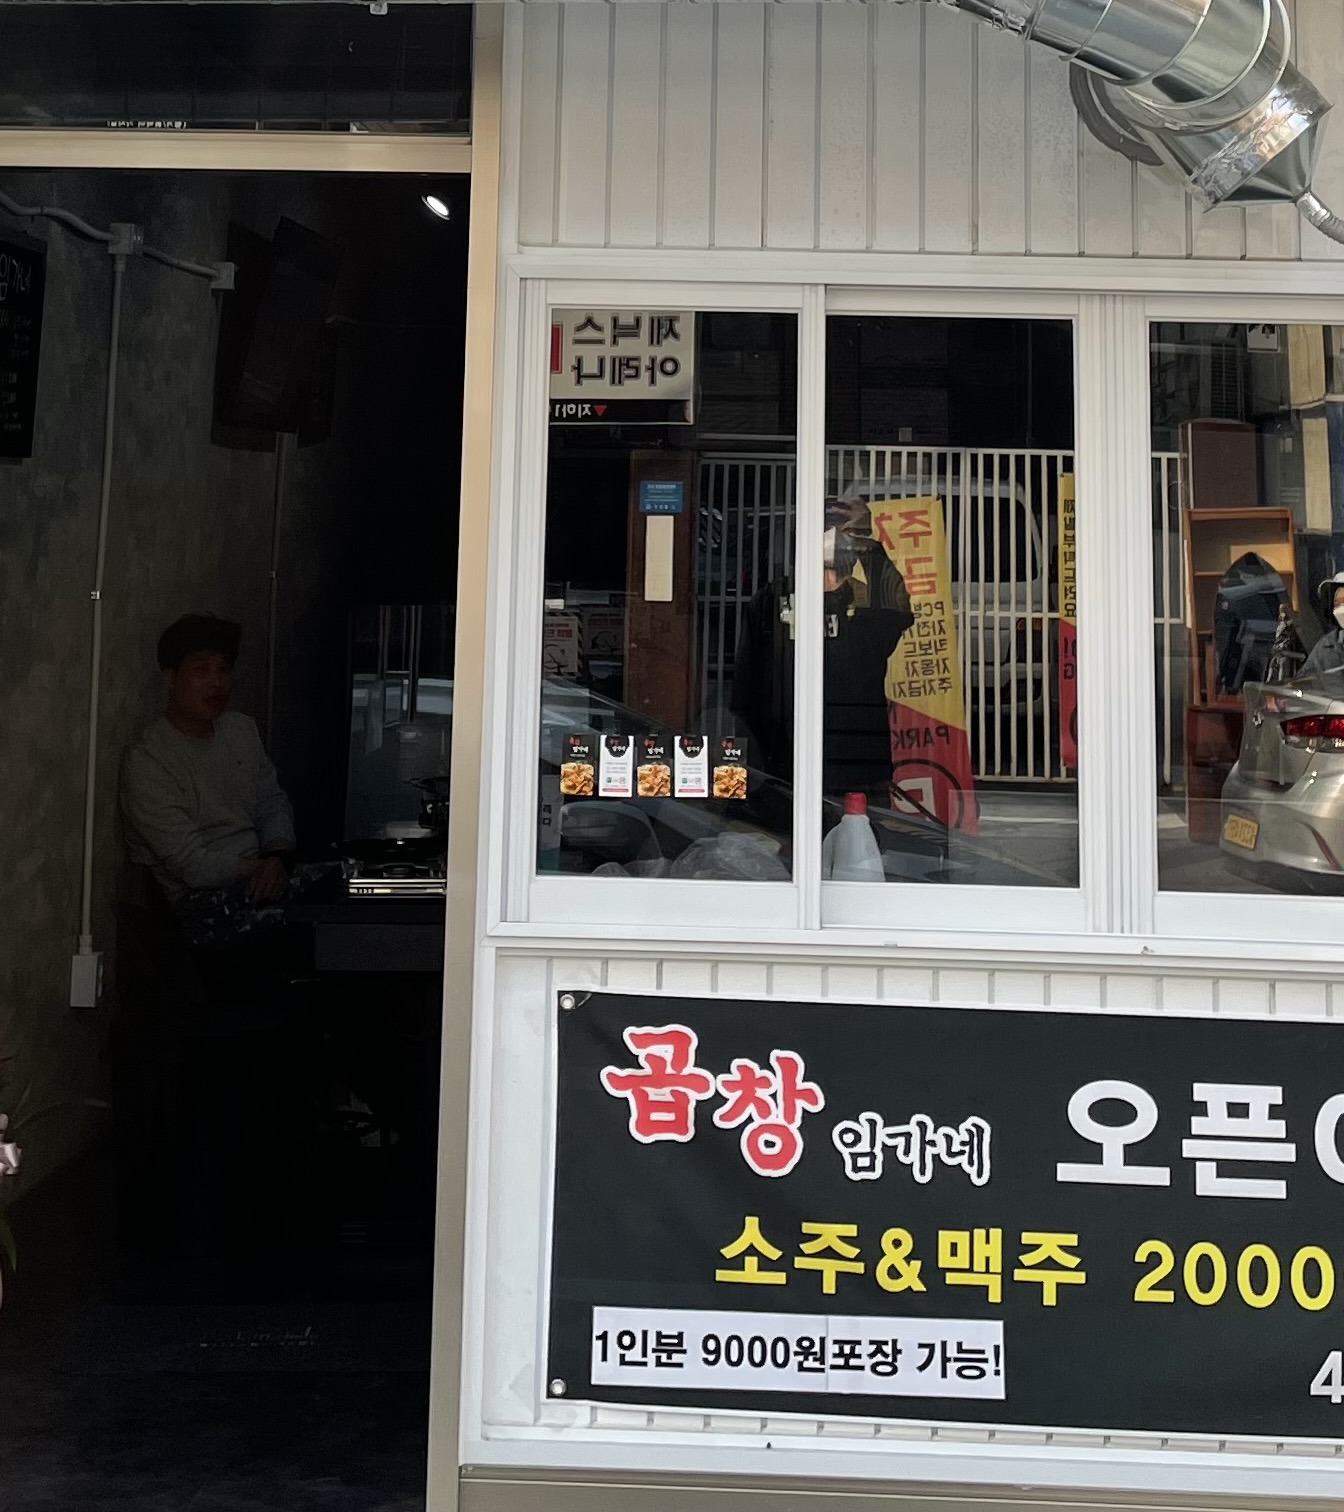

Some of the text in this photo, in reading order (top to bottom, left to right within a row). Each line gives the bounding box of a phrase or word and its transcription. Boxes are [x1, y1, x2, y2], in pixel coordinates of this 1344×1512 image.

[599, 1023, 825, 1180] 곱창
[830, 1112, 995, 1188] 임가네
[713, 1214, 1088, 1309] 소주&맥주
[592, 1327, 1004, 1383] 1인분 9000원포장 가능!
